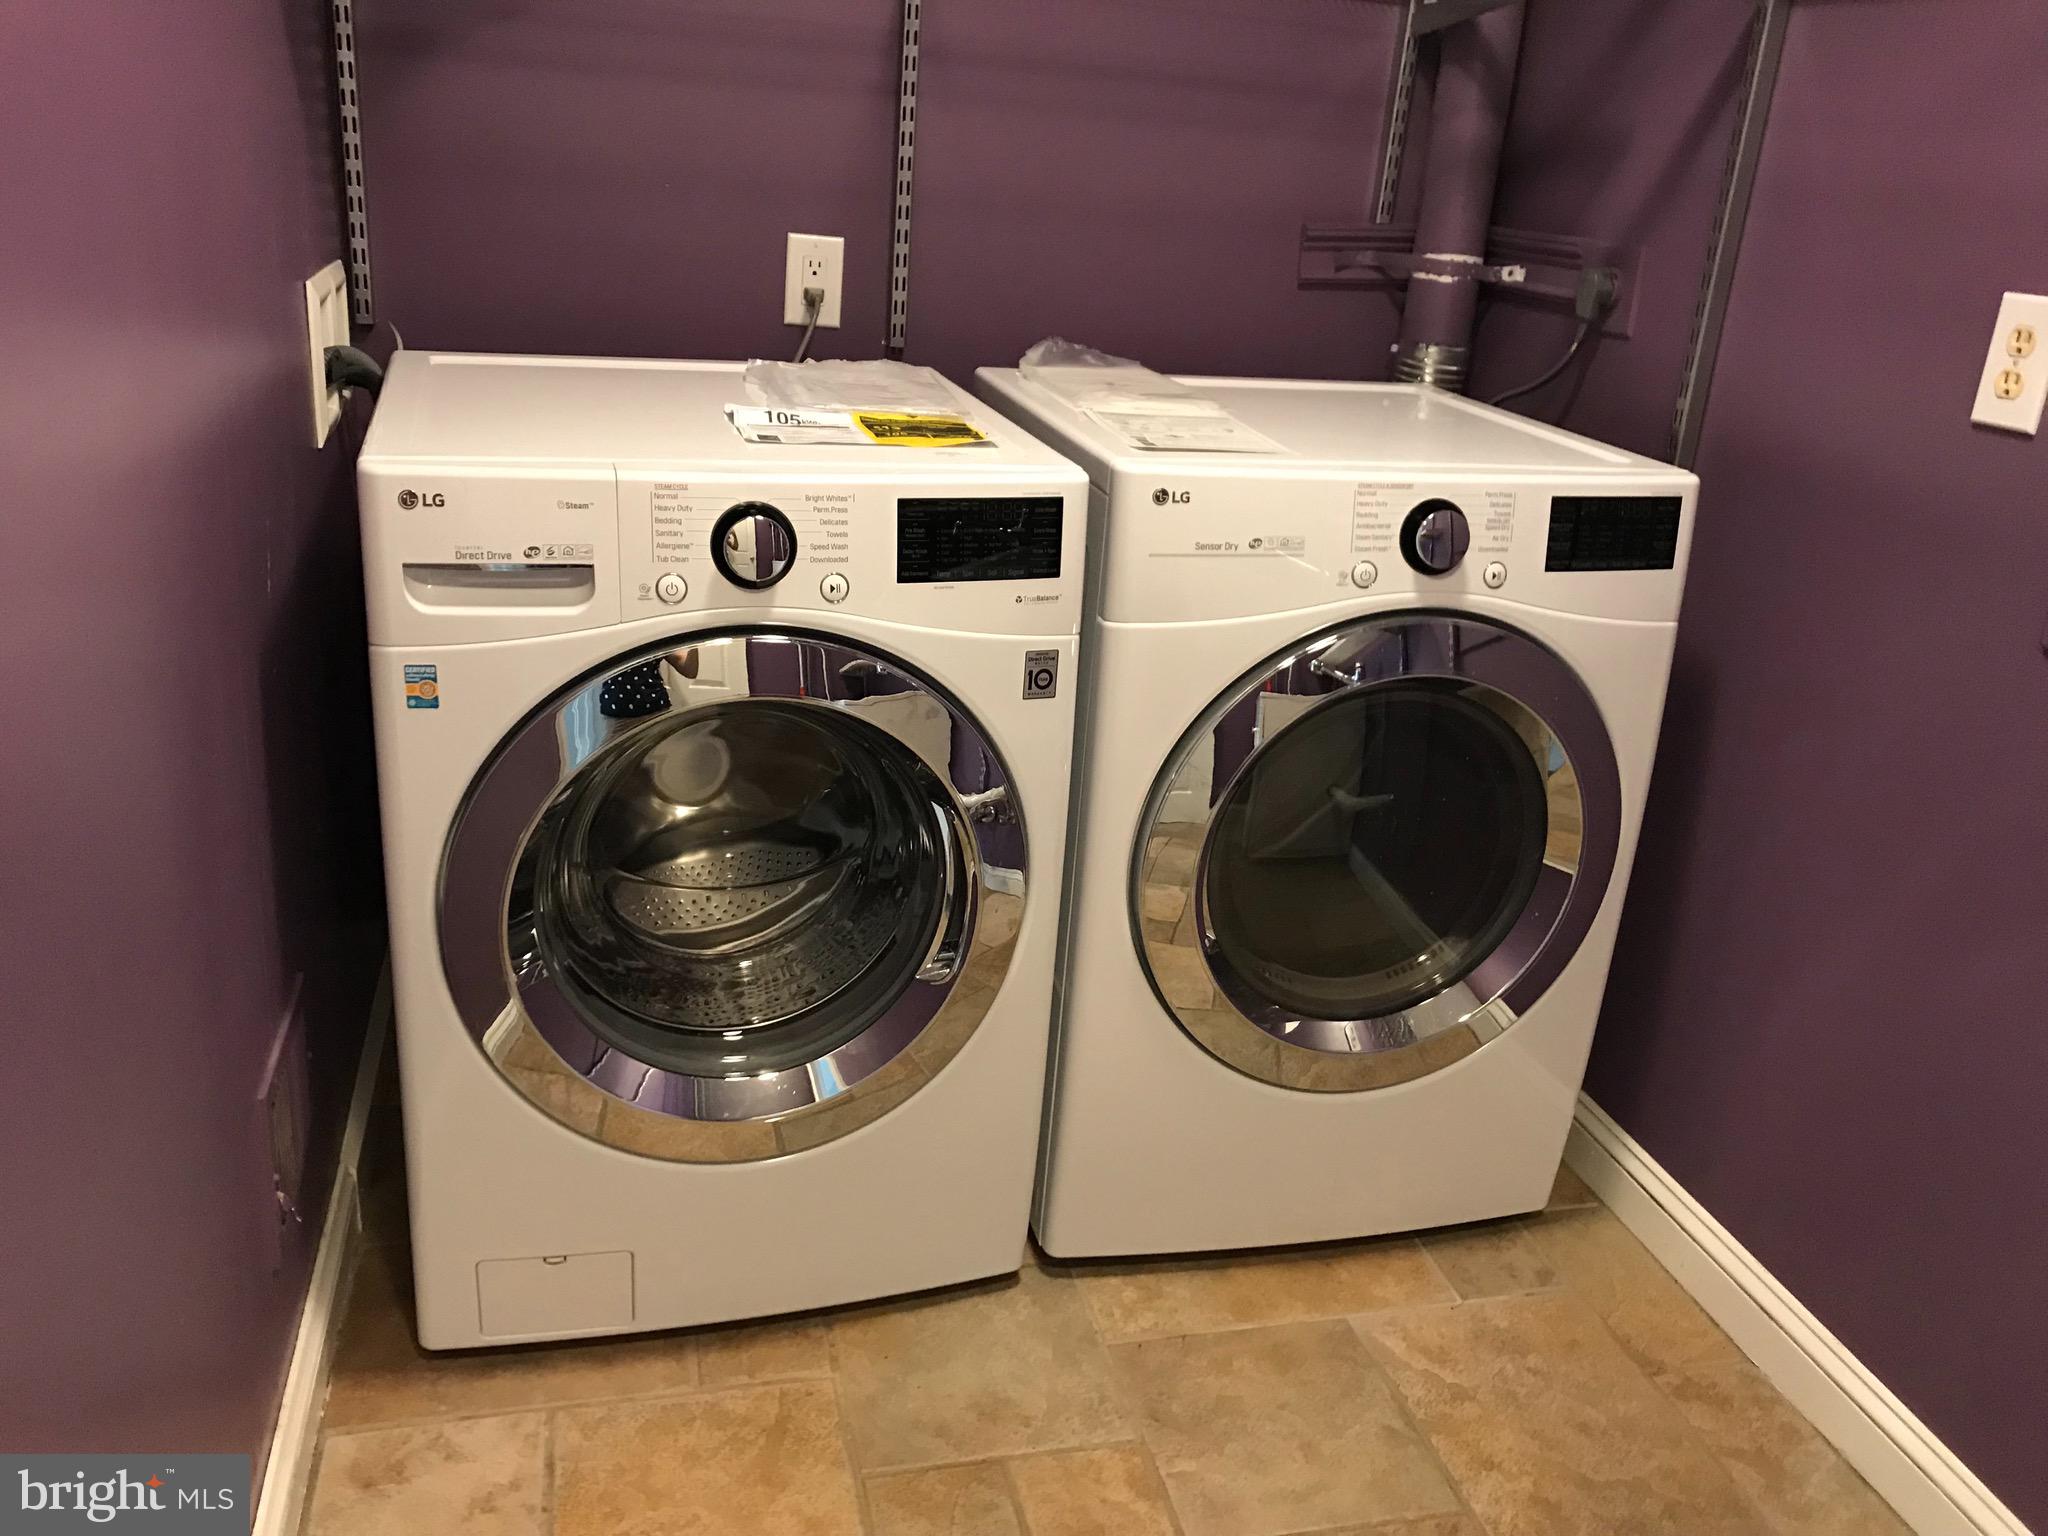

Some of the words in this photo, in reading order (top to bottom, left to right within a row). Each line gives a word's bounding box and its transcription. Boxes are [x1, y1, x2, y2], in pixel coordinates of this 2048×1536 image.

[764, 410, 801, 425] 105
[422, 493, 445, 508] LG
[654, 492, 679, 500] Normal
[805, 494, 824, 503] Bright
[1172, 491, 1191, 504] LG
[654, 504, 676, 513] Heavy
[677, 504, 693, 513] Duty
[654, 516, 683, 526] Bedding
[820, 518, 848, 526] Delicates
[656, 529, 684, 538] Sanitary
[826, 530, 848, 538] Towels
[810, 543, 830, 552] Speed
[1195, 542, 1223, 551] Sensor
[1224, 542, 1239, 552] Dry
[455, 550, 484, 560] Direct
[487, 550, 512, 560] Drive
[1028, 668, 1054, 691] 10
